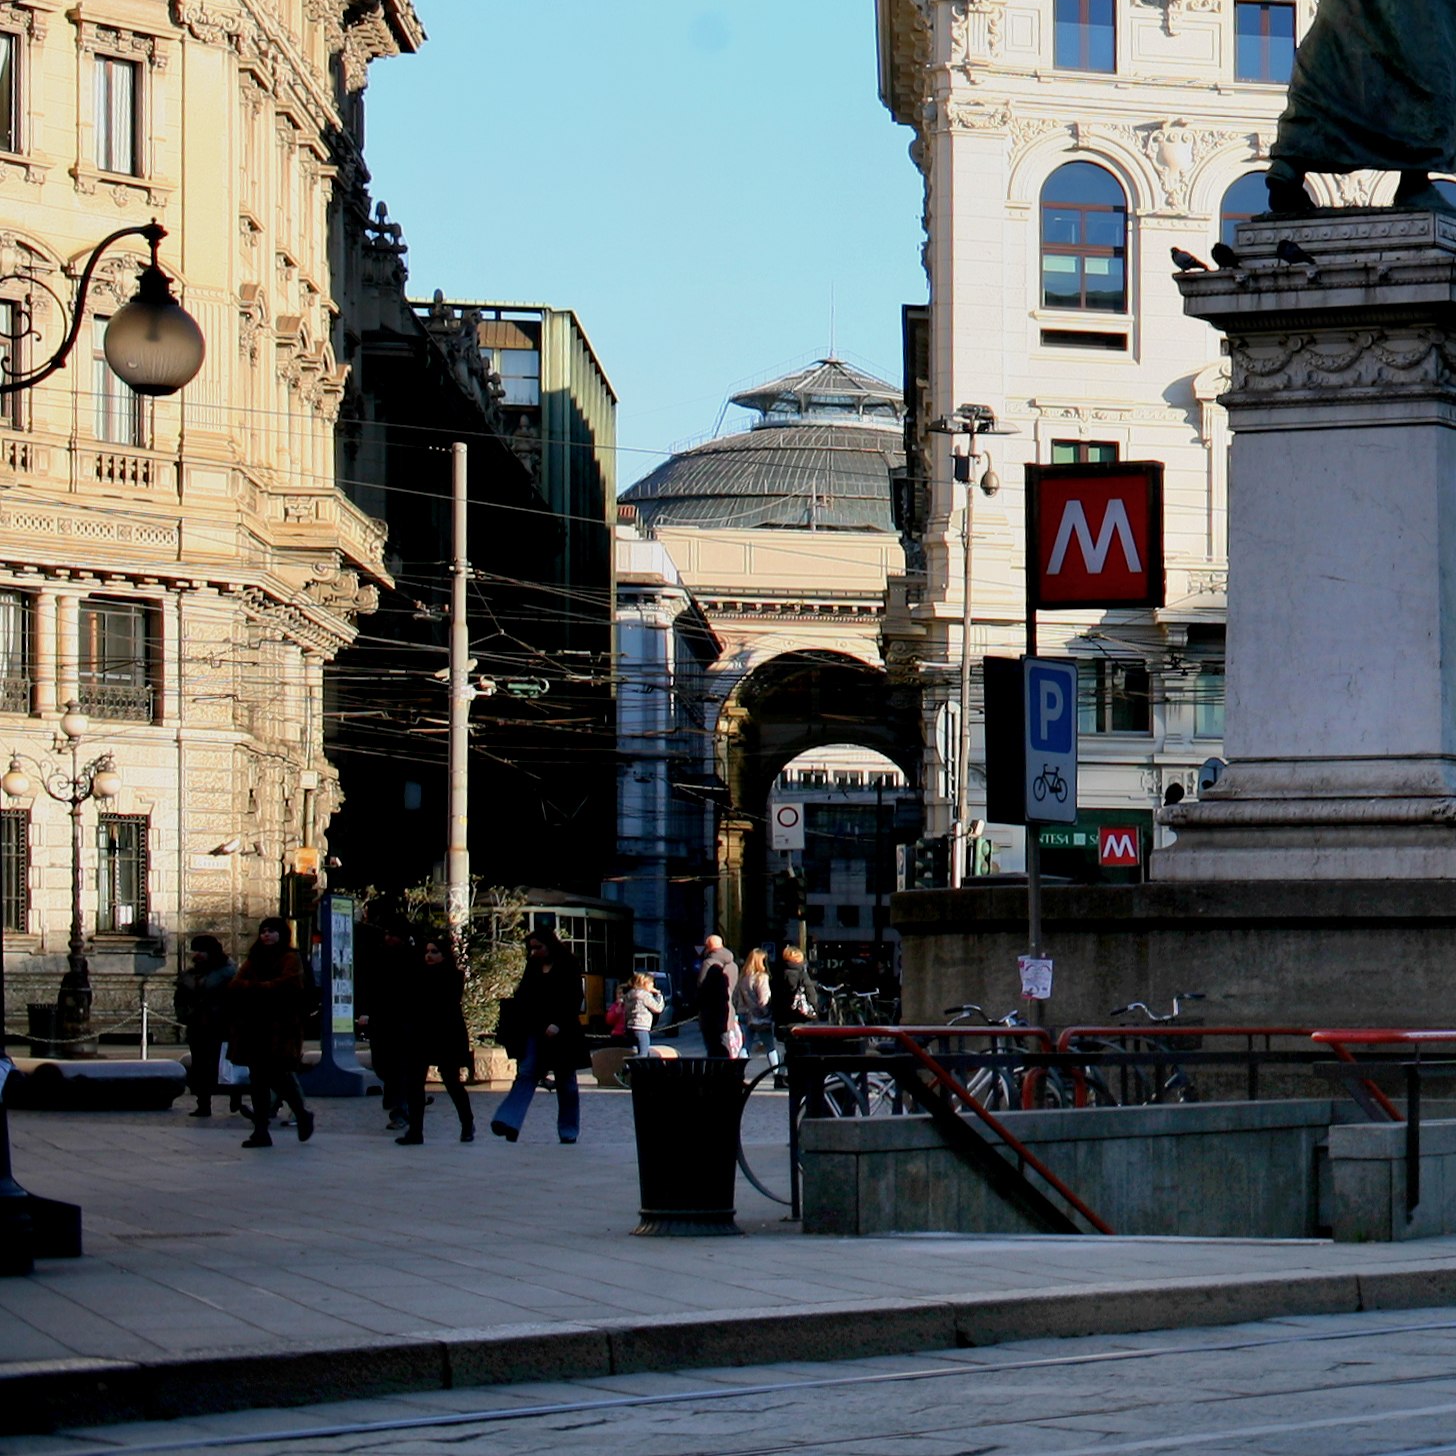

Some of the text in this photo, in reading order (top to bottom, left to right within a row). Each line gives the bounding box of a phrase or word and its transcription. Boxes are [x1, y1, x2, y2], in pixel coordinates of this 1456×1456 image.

[1046, 498, 1142, 574] M
[1040, 680, 1063, 740] P
[1102, 834, 1137, 859] M
